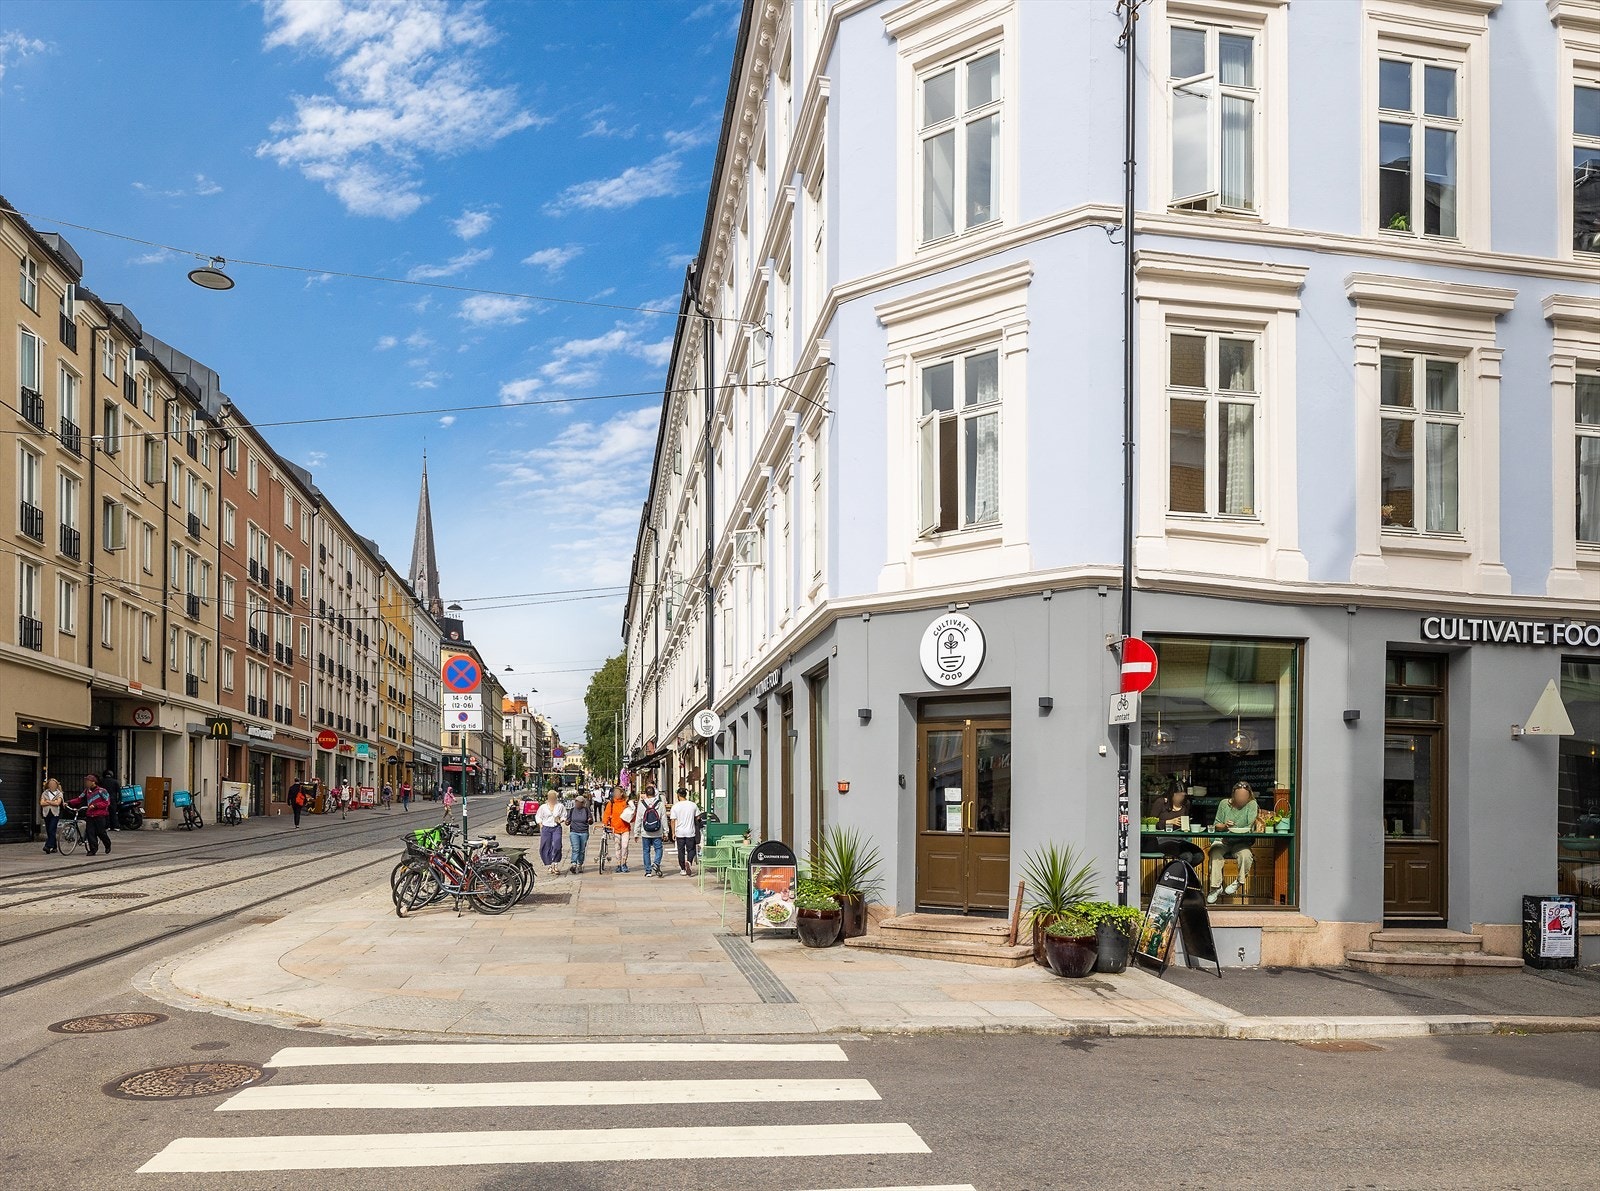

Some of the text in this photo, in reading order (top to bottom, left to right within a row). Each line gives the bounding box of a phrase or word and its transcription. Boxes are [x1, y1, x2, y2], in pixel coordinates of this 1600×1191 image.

[933, 620, 970, 636] CULTIVATE
[1423, 617, 1546, 644] CULTIVATE
[940, 671, 963, 680] FOOD
[1548, 907, 1560, 916] 50
